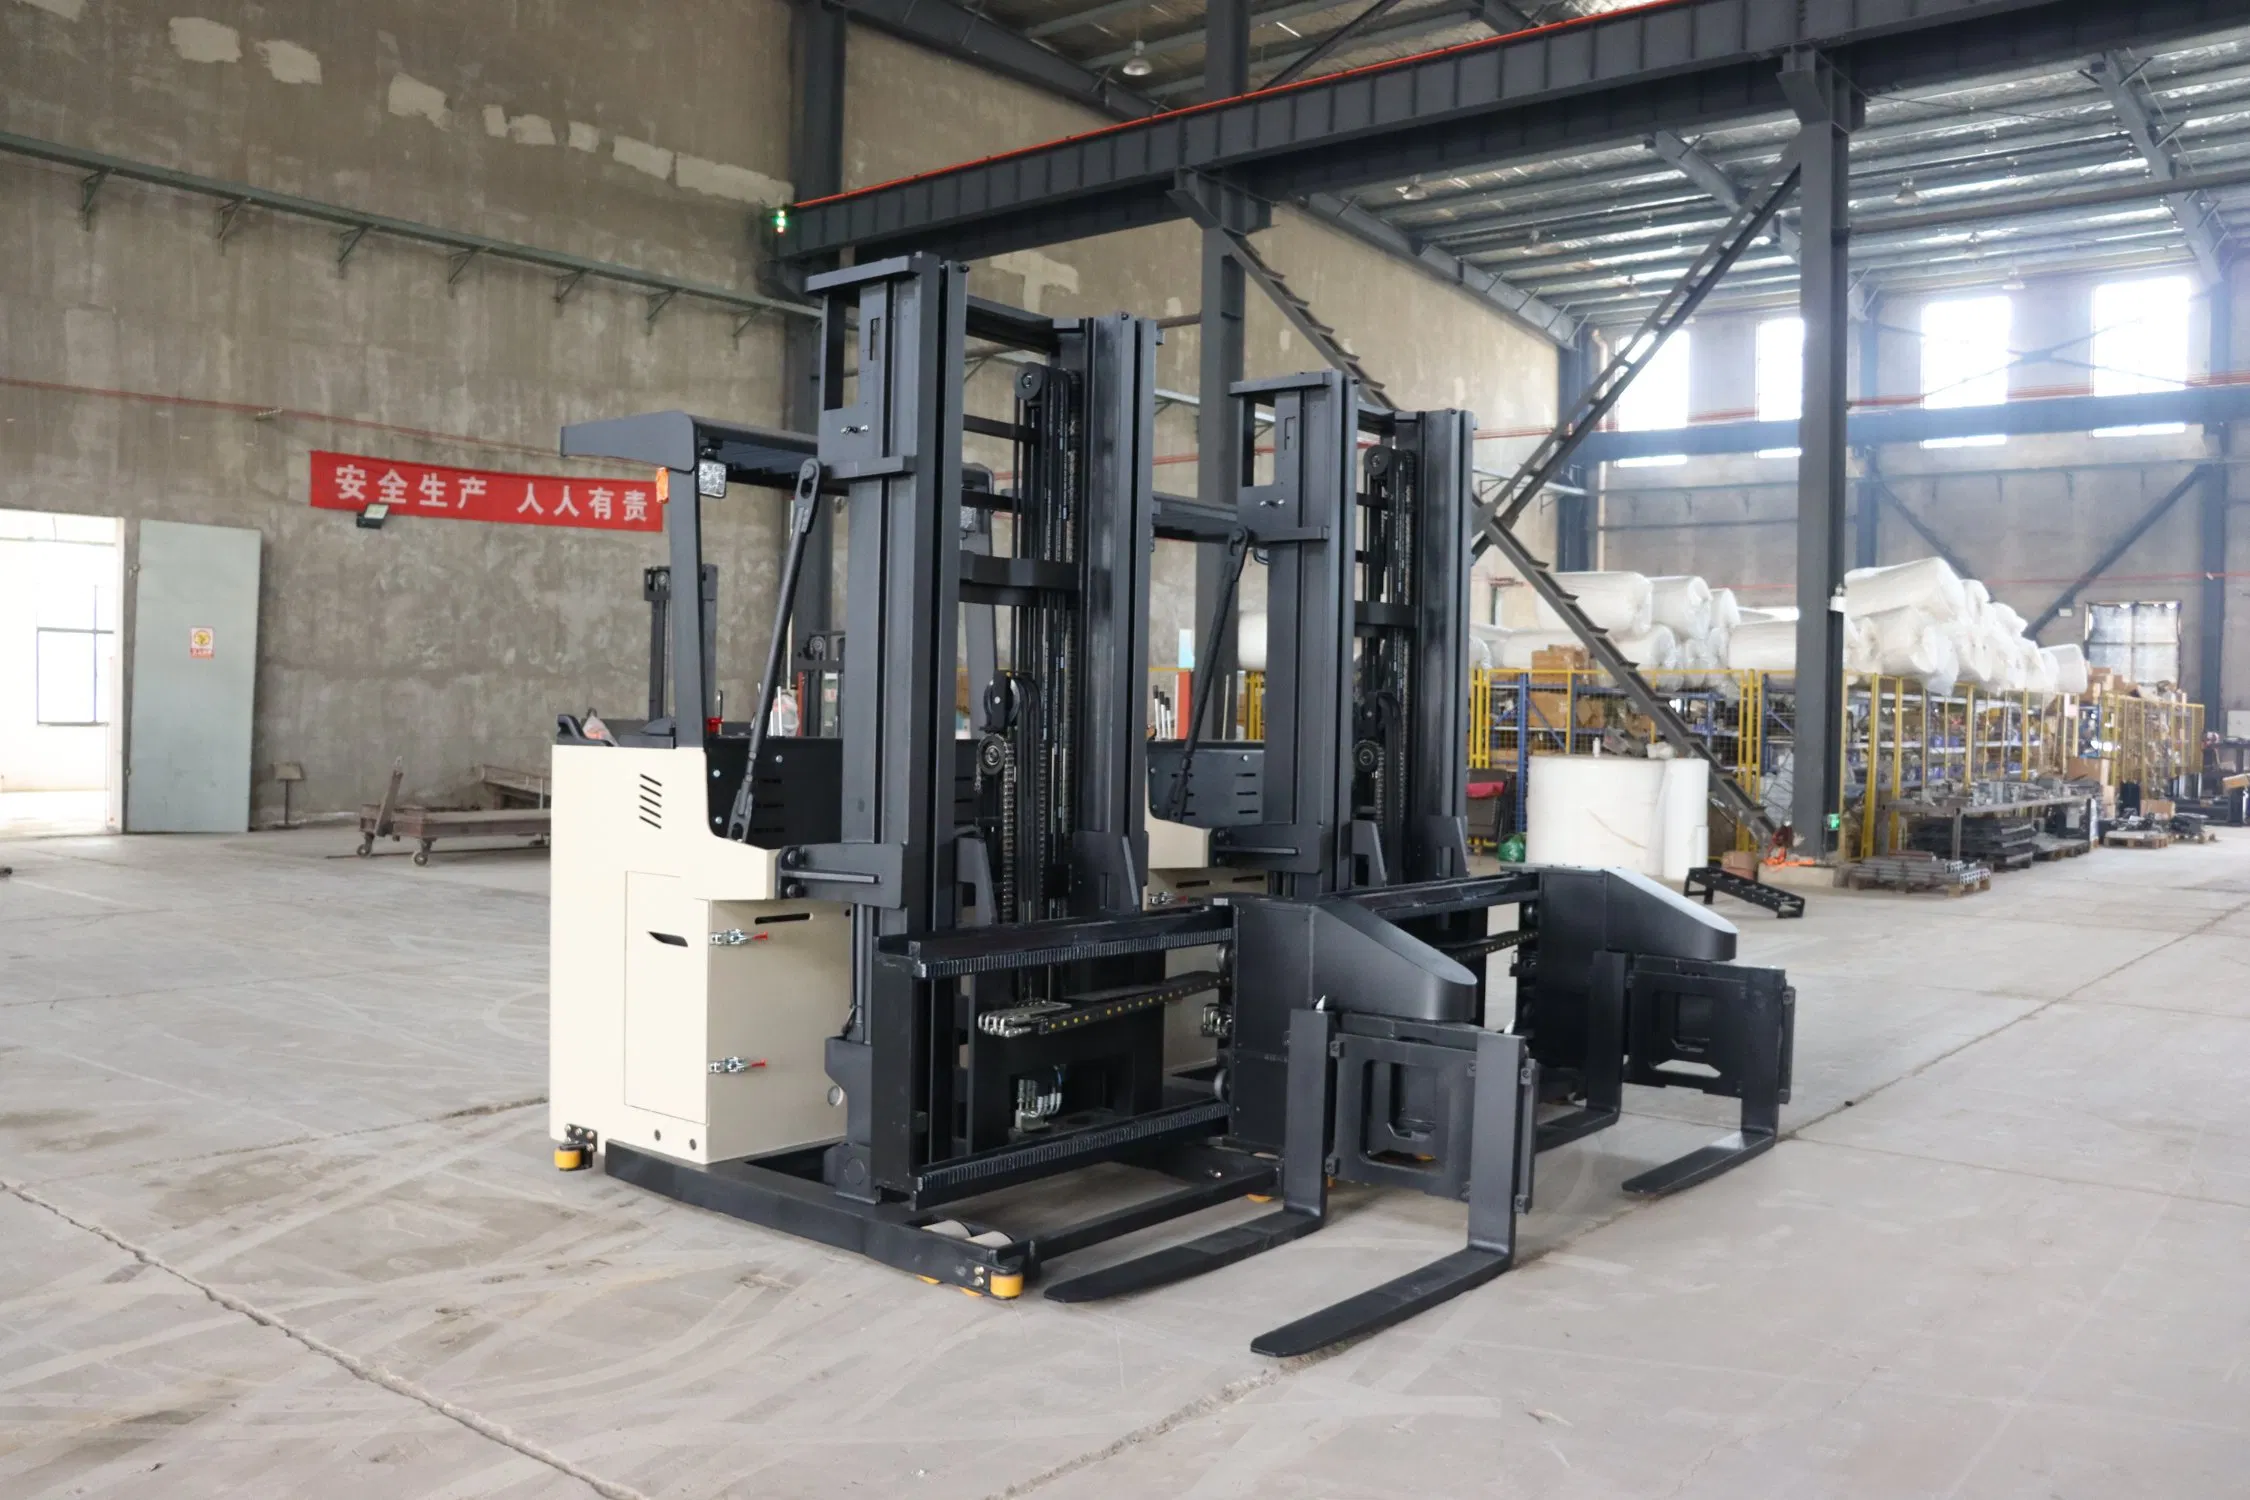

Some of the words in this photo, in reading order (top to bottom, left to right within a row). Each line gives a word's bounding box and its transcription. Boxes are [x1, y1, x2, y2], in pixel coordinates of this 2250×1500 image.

[335, 464, 487, 509] 安全生产
[516, 481, 648, 522] 人人有责
